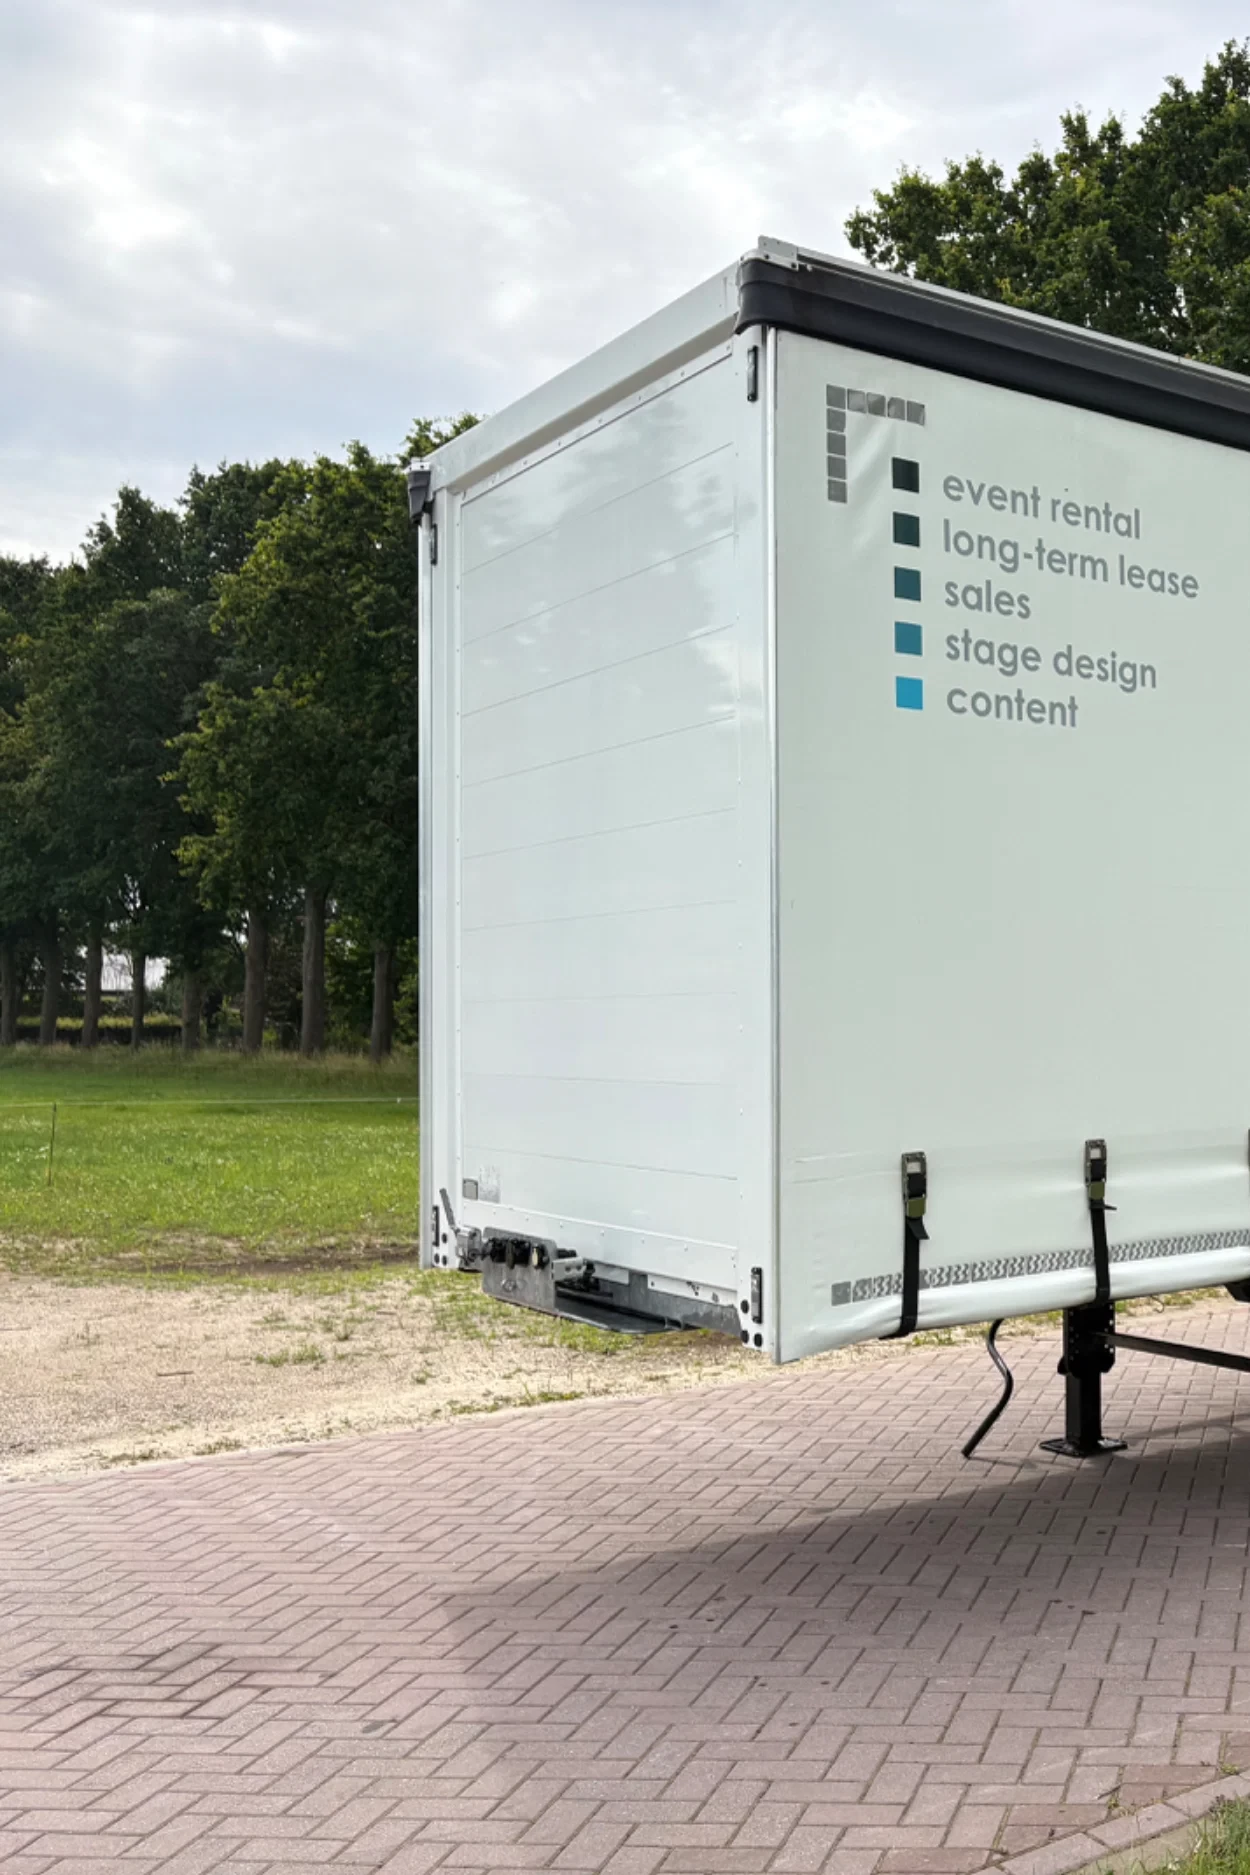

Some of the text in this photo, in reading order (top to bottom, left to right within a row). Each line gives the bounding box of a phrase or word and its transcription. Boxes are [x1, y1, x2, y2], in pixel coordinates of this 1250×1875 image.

[942, 474, 1141, 540] event rental
[943, 518, 1200, 599] long-term lease
[944, 579, 1032, 620] sales
[945, 628, 1157, 694] stage design
[946, 687, 1079, 728] content
